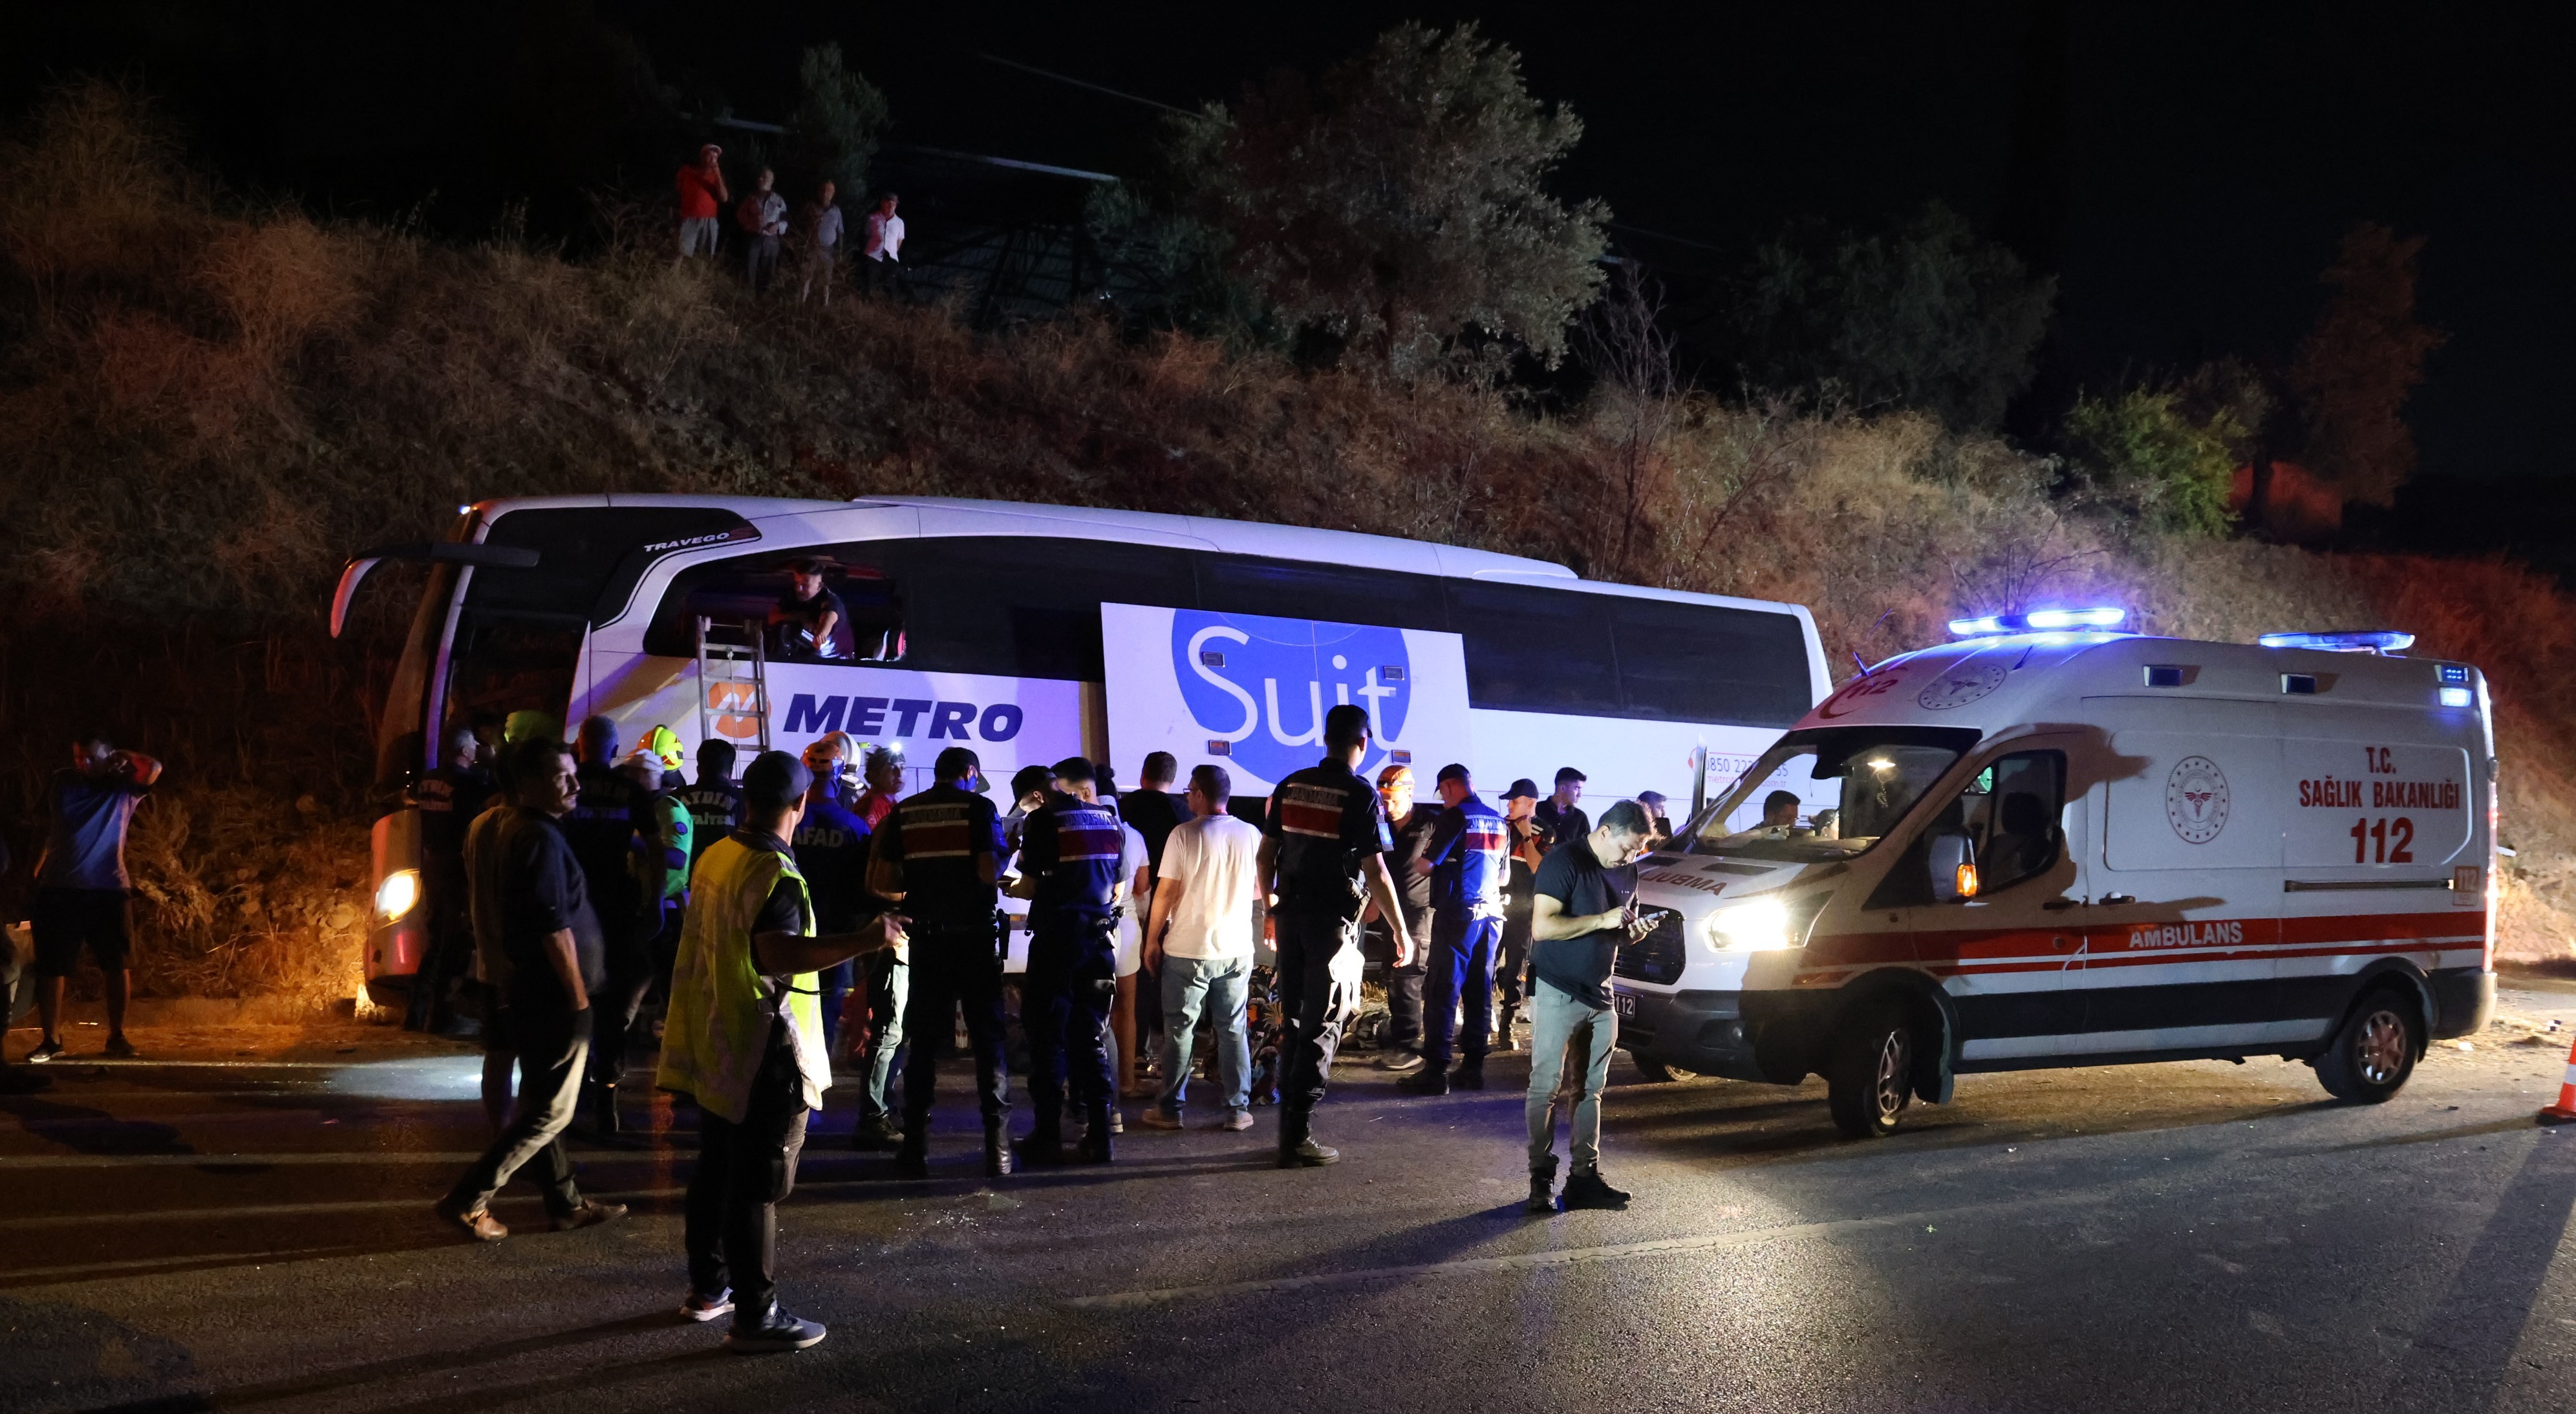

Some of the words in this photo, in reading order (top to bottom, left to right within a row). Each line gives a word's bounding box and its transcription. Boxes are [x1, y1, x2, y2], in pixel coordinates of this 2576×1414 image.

[643, 532, 729, 552] TRAVEGO
[1188, 625, 1397, 751] Suit
[1847, 679, 1899, 698] 112
[783, 693, 1023, 742] METRO
[1734, 759, 1753, 773] 22
[2366, 747, 2397, 774] T.C.
[2299, 775, 2363, 808] SAĞLIK
[2373, 778, 2460, 809] BAKANLIĞI
[792, 827, 844, 848] AFAD
[2350, 817, 2414, 863] 112
[2129, 921, 2243, 948] AMBULANS
[1616, 996, 1633, 1015] 112
